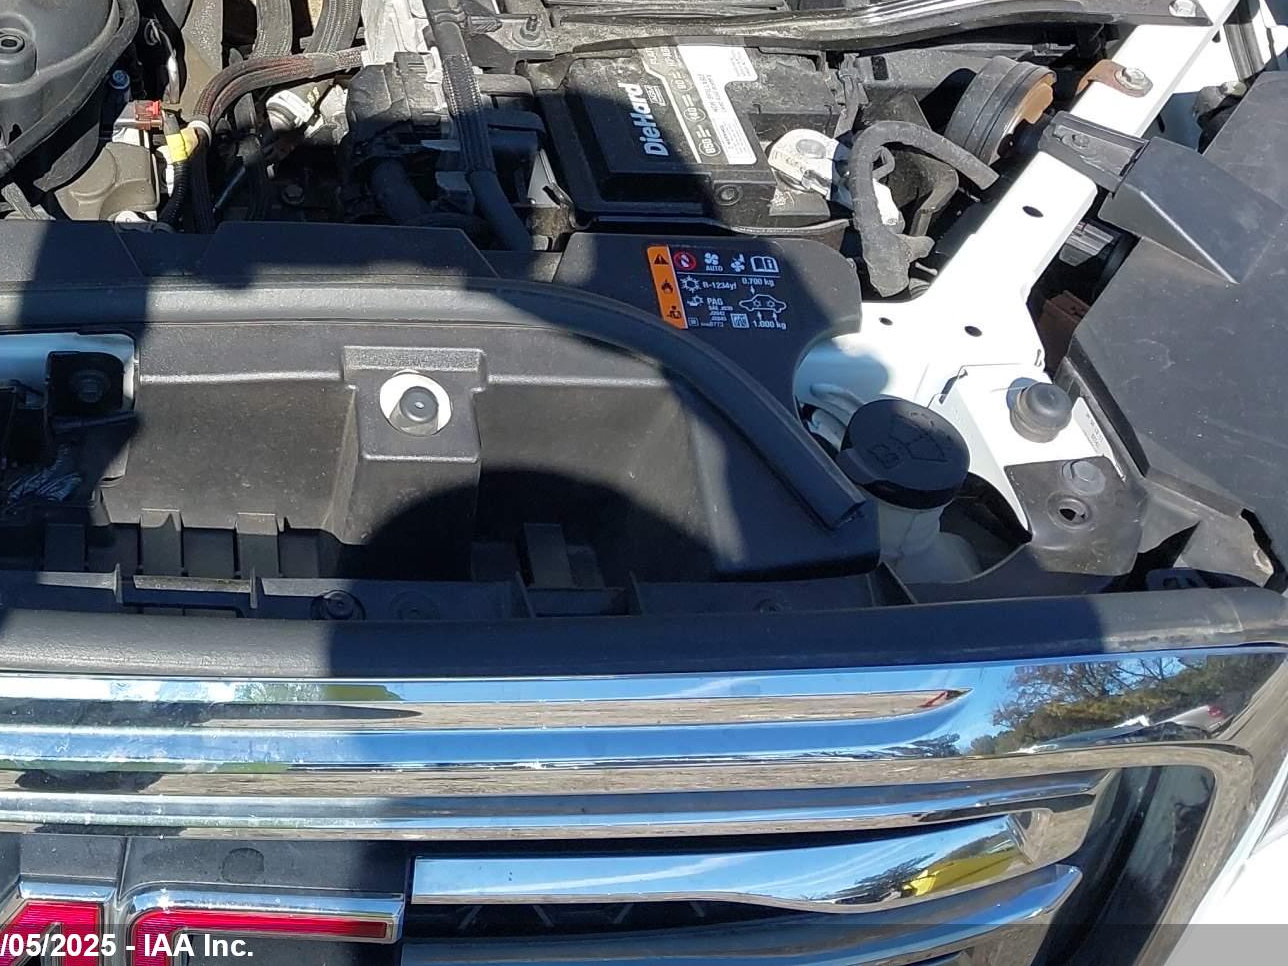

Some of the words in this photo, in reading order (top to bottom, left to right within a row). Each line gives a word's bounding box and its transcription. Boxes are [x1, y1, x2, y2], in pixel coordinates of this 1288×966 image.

[618, 81, 669, 156] DieHard
[702, 281, 737, 291] R-1234yf
[742, 277, 763, 286] 0.700
[764, 278, 775, 288] kg
[707, 297, 724, 306] PAG
[753, 320, 775, 328] 1.000
